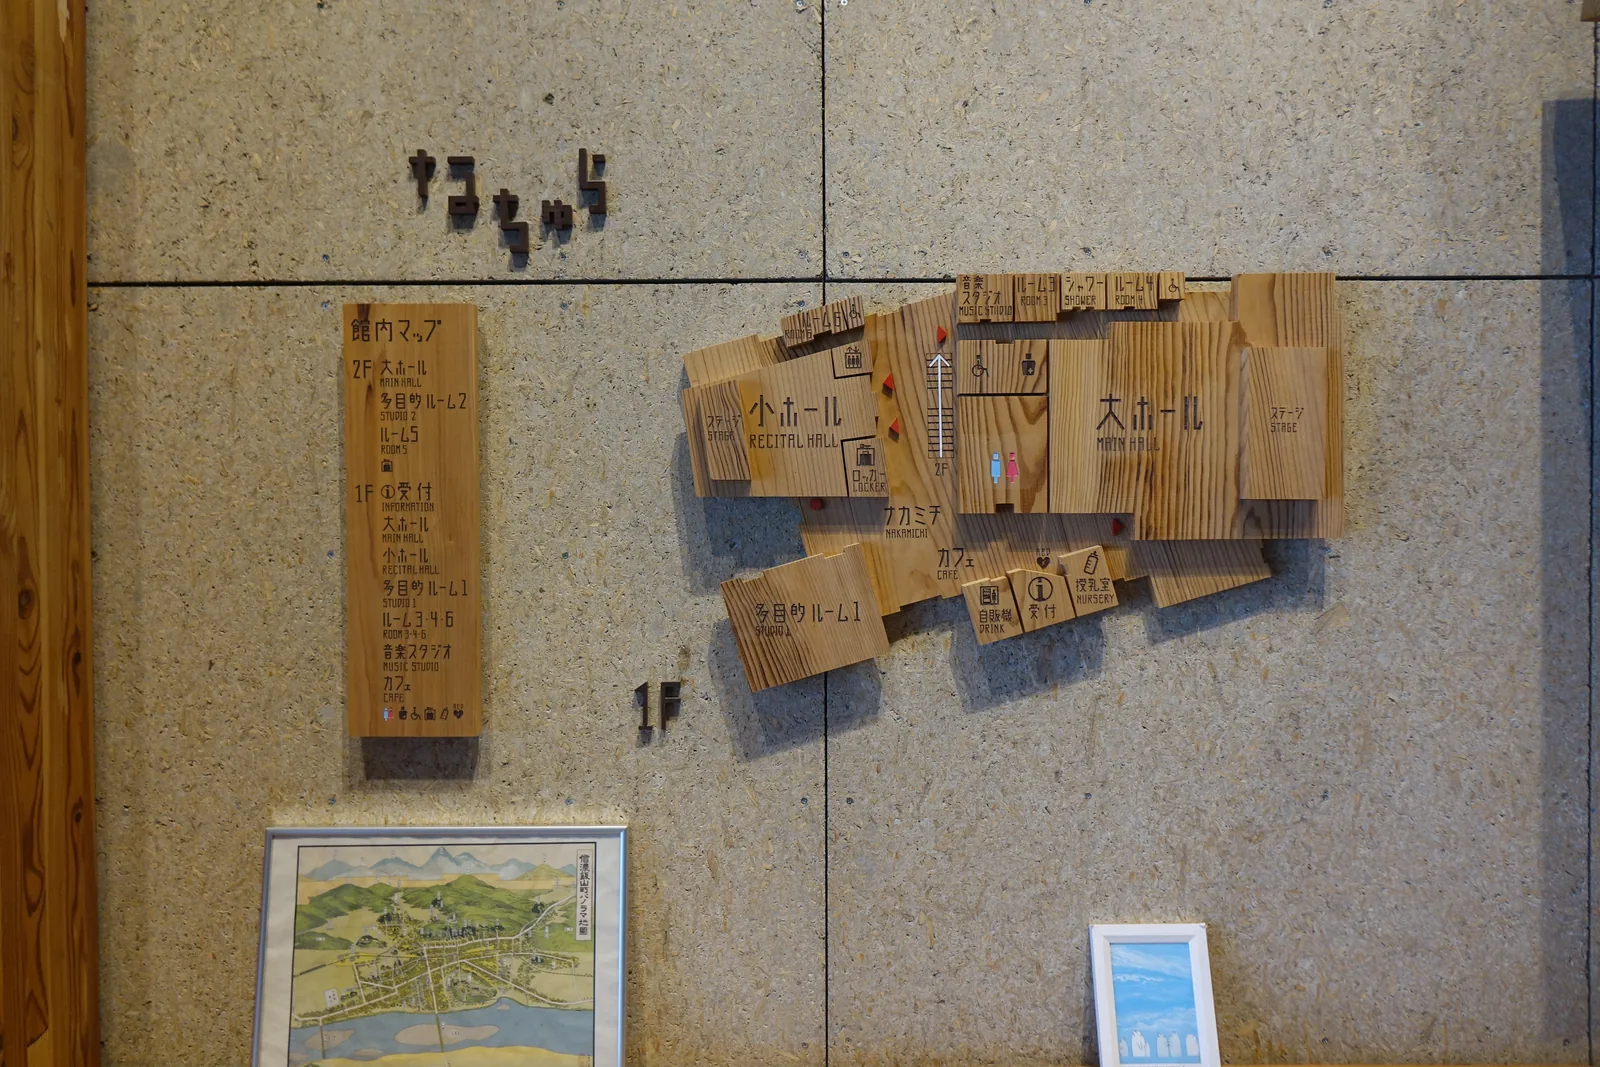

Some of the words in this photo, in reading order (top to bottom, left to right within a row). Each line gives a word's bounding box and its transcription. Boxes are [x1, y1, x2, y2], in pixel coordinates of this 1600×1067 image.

[962, 275, 984, 290] 音楽
[1017, 276, 1056, 293] ルーム3
[1066, 276, 1104, 292] シャワー
[1115, 275, 1154, 292] ルーム4
[962, 290, 1002, 305] スタジオ
[1020, 295, 1041, 306] ROOM
[1043, 296, 1049, 306] 3
[1064, 295, 1097, 306] SHOWER
[1115, 295, 1135, 305] ROOM
[958, 305, 983, 316] MUSIC
[985, 305, 1013, 316] STUDIO
[350, 318, 442, 342] 館内マップ
[784, 328, 806, 340] ROOM
[352, 359, 372, 379] 2F
[380, 359, 427, 375] 大ホール
[379, 377, 399, 388] MAIN
[401, 377, 422, 388] HALL
[380, 392, 467, 410] 多目的ルーム2
[380, 411, 408, 421] STUDIO
[410, 411, 417, 421] 2
[748, 394, 842, 428] 小ホール
[1096, 393, 1203, 431] 大ホール
[1270, 406, 1304, 420] ステージ
[707, 414, 741, 428] ステージ
[1270, 422, 1298, 433] STAGE
[380, 425, 419, 443] ルーム5
[707, 430, 735, 441] STAGE
[749, 434, 804, 449] RECITAL
[807, 433, 838, 448] HALL
[380, 444, 401, 455] ROOM
[1096, 436, 1126, 452] MAIN
[1129, 436, 1160, 452] HALL
[934, 462, 949, 477] 2F
[355, 484, 374, 503] 1F
[397, 481, 432, 501] 受付
[852, 481, 886, 493] LOCKER
[381, 502, 435, 512] INFORMATION
[884, 505, 941, 526] ナカミチ
[382, 515, 429, 532] 大ホール
[381, 533, 401, 544] MAIN
[403, 533, 424, 544] HALL
[885, 528, 928, 539] NAKAMICHI
[382, 547, 429, 564] 小ホール
[937, 547, 975, 568] カフェ
[382, 565, 418, 575] RECITAL
[419, 565, 440, 575] HALL
[937, 569, 959, 580] CAFE
[383, 579, 468, 597] 多目的ルーム1
[1075, 577, 1111, 593] 授乳室
[382, 598, 410, 609] STUDIO
[1076, 593, 1115, 605] NURSERY
[755, 601, 861, 624] 多目的ルーム1
[979, 608, 1013, 624] 自販機
[1028, 603, 1056, 620] 受付
[382, 629, 403, 640] ROOM
[755, 625, 784, 637] STUDIO
[979, 623, 1005, 634] DRINK
[383, 643, 452, 660] 音楽スタジオ
[382, 661, 409, 672] MUSIC
[411, 661, 439, 672] STUDIO
[383, 675, 412, 692] カフェ
[383, 693, 405, 703] CAFE
[634, 680, 681, 731] 1F
